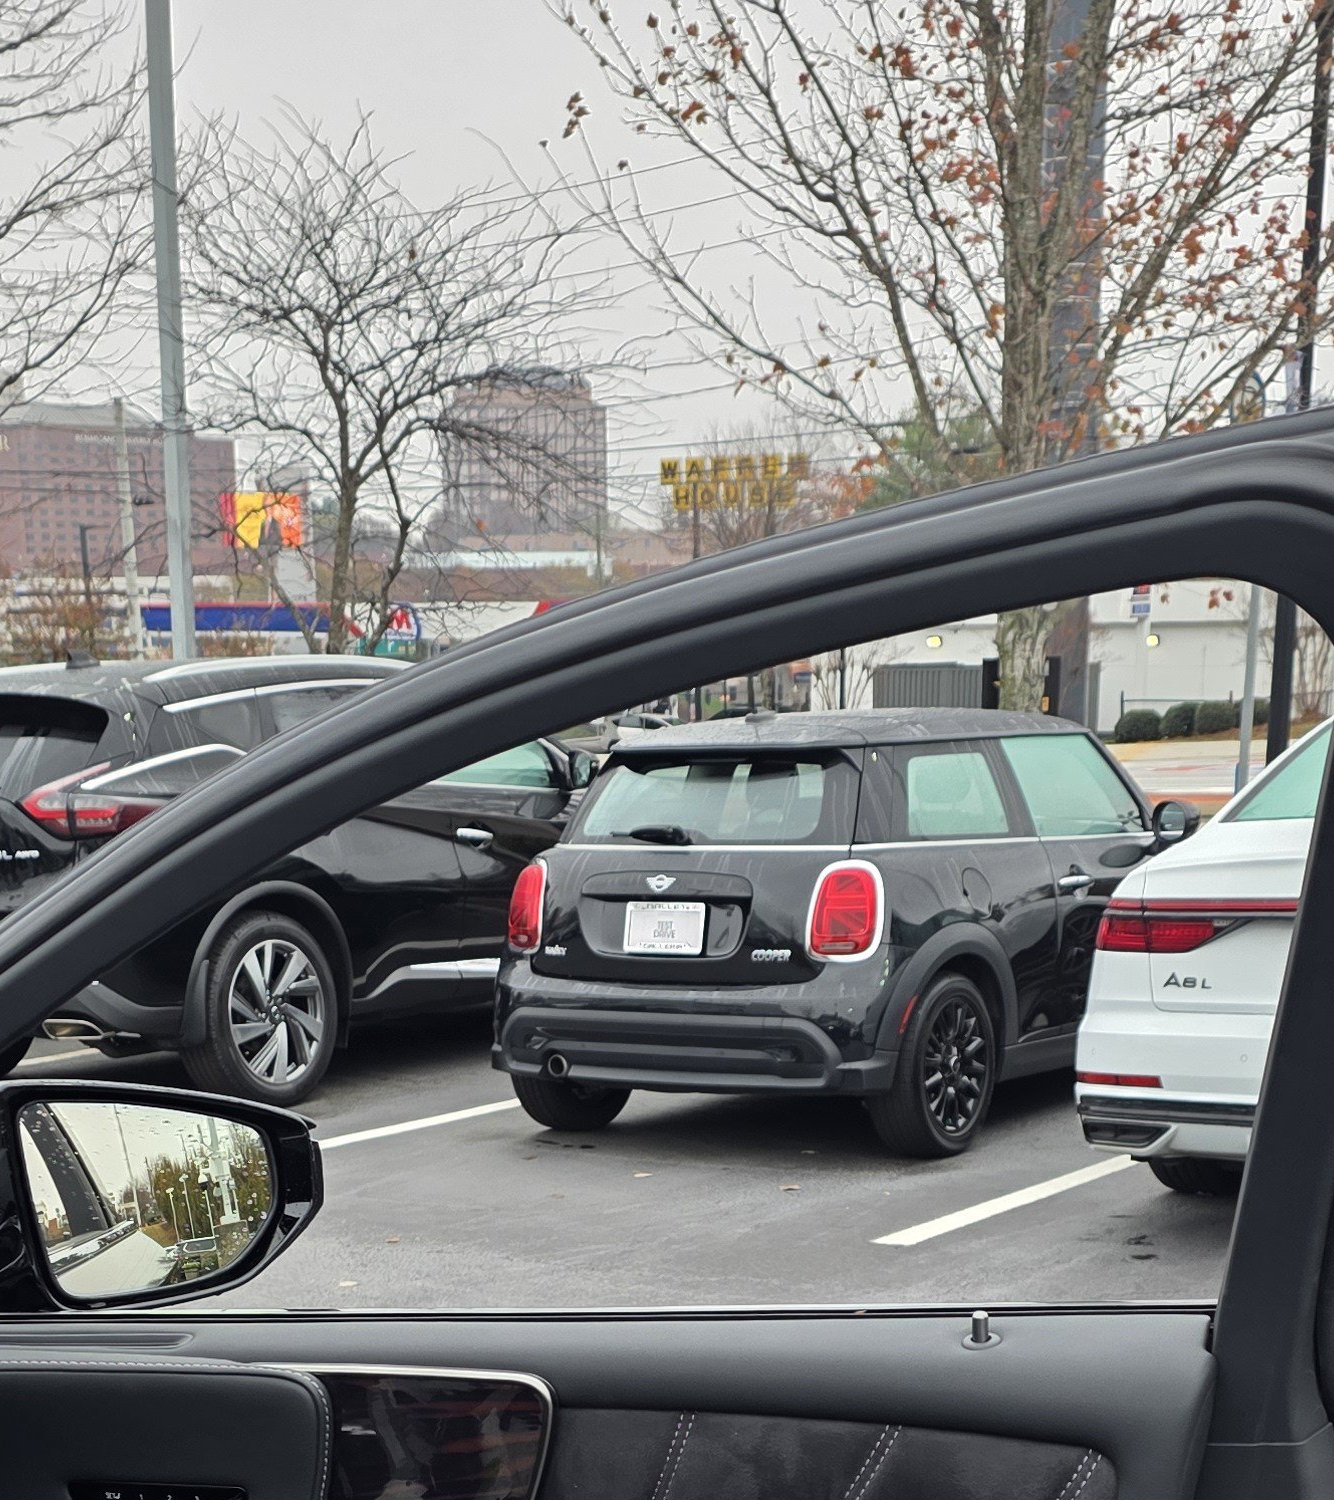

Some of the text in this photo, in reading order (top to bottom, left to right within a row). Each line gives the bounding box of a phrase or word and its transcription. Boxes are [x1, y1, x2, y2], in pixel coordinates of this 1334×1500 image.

[675, 484, 795, 506] HOUSE
[657, 920, 674, 930] TEST
[653, 929, 676, 939] DRIVE
[751, 949, 792, 961] COOPER
[1163, 971, 1197, 988] A8
